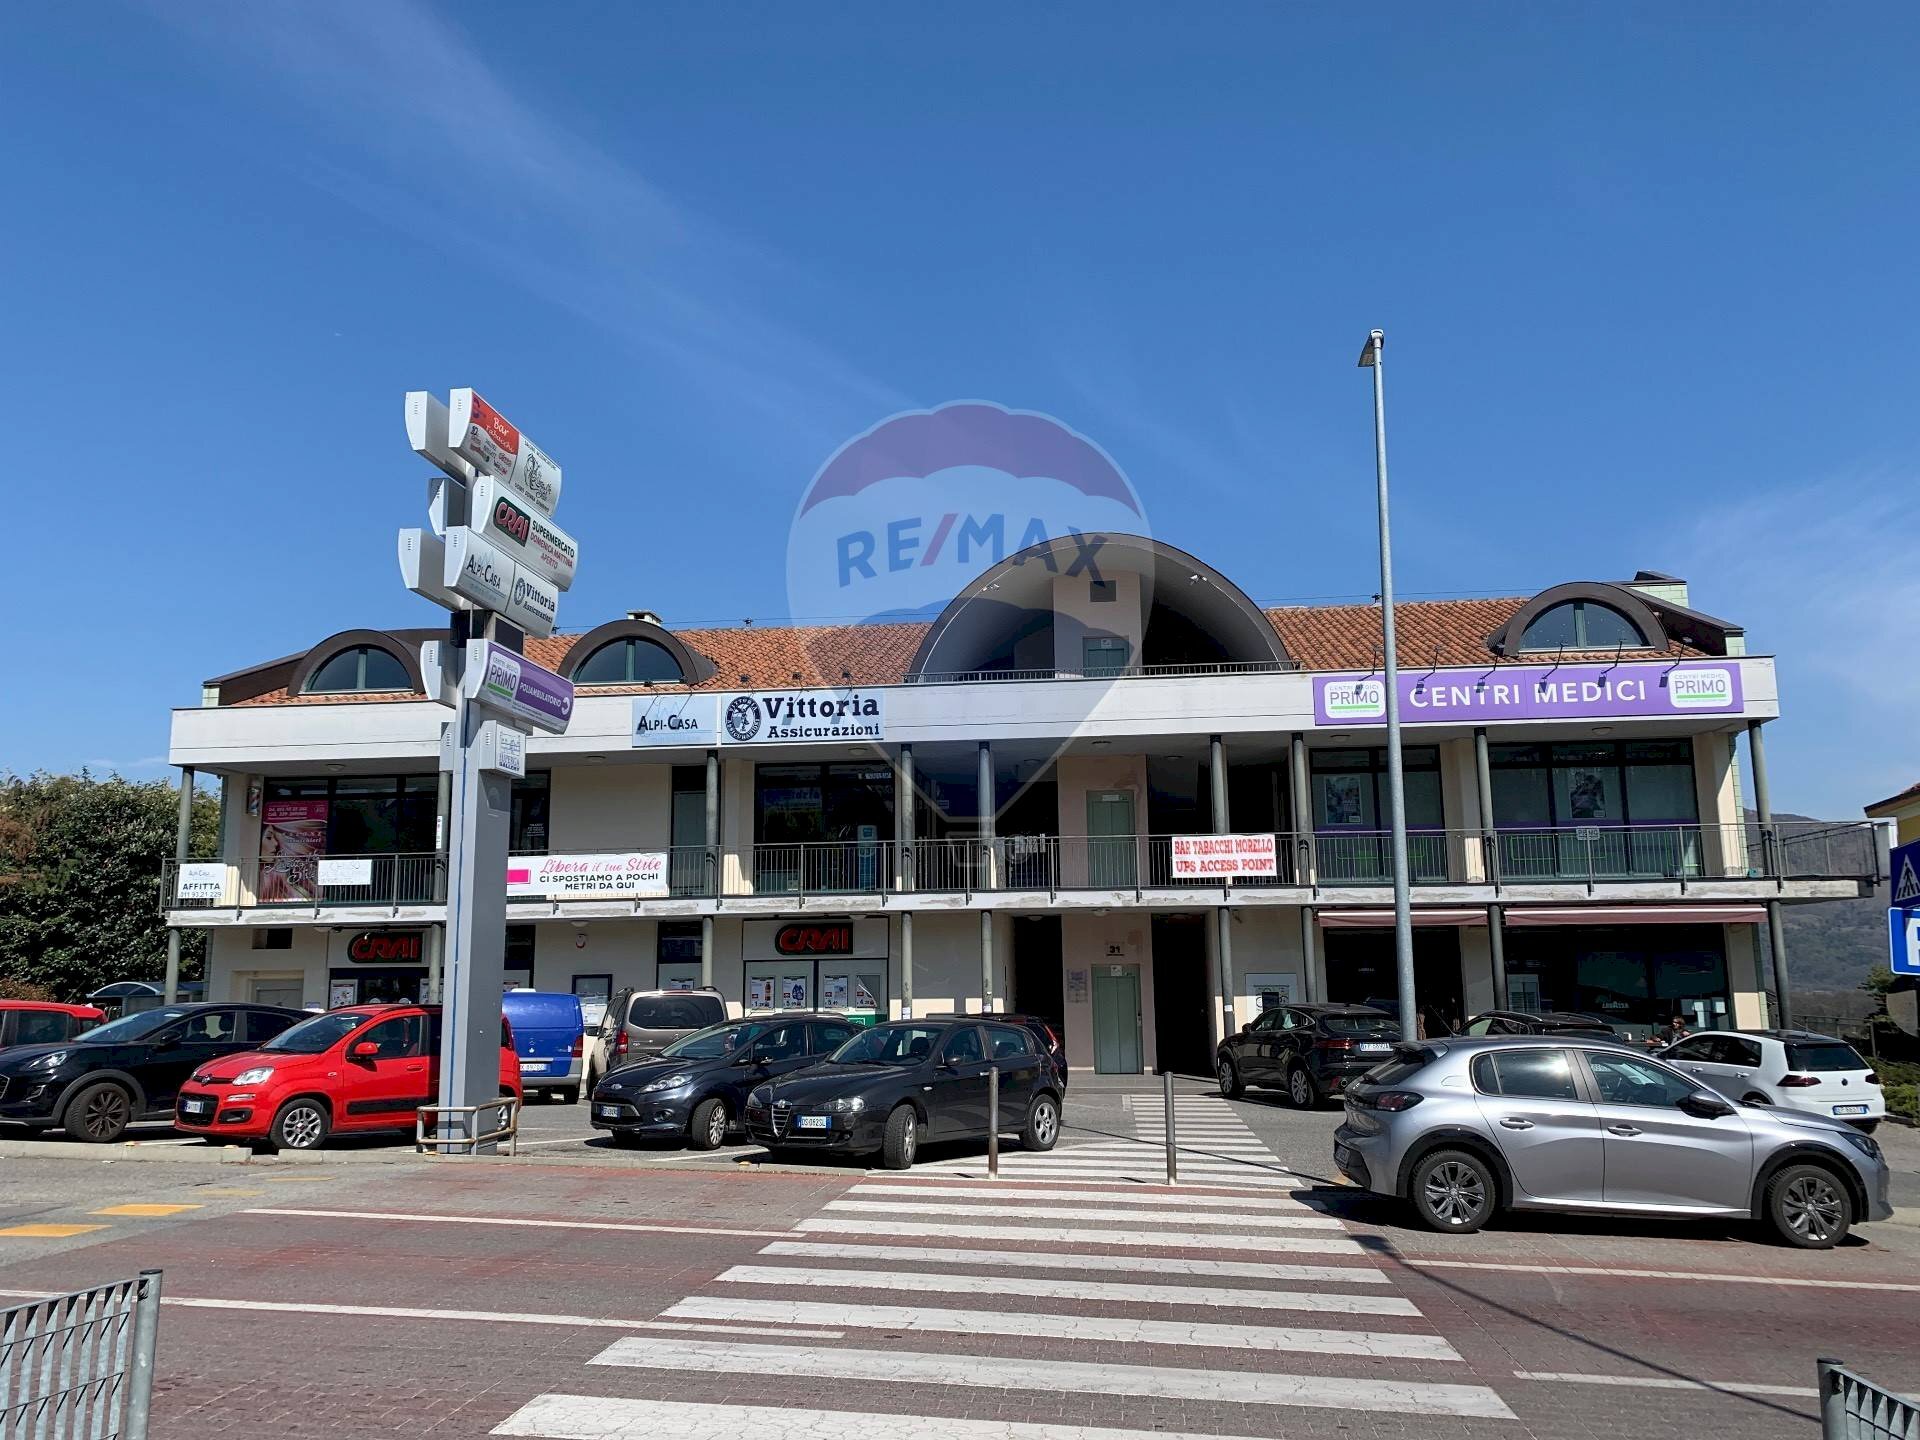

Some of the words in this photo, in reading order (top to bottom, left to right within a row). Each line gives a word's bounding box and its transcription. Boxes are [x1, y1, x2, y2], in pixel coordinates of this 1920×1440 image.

[493, 417, 509, 436] Bar
[495, 502, 529, 540] CRAI
[532, 519, 575, 558] SUPERMERCATO
[526, 582, 556, 612] Vittoria
[489, 665, 517, 692] PRIMO
[1674, 679, 1726, 694] PRIMO
[1329, 690, 1379, 705] PRIMO
[1409, 684, 1520, 708] CENTRI
[1534, 680, 1646, 704] MEDICI
[762, 694, 880, 718] Vittoria
[767, 723, 880, 739] Assicurazioni
[1174, 840, 1191, 855] BAR
[1193, 839, 1233, 855] TABACCHI
[1235, 838, 1273, 853] MORELLO
[540, 858, 588, 874] Libera
[626, 857, 661, 872] Stile
[1175, 860, 1197, 873] UPS
[1200, 859, 1239, 872] ACCESS
[1241, 858, 1274, 870] POINT
[540, 875, 551, 883] CI
[552, 874, 613, 882] SPOSTIAMO
[351, 937, 420, 960] CRAI
[778, 927, 850, 951] CRAI
